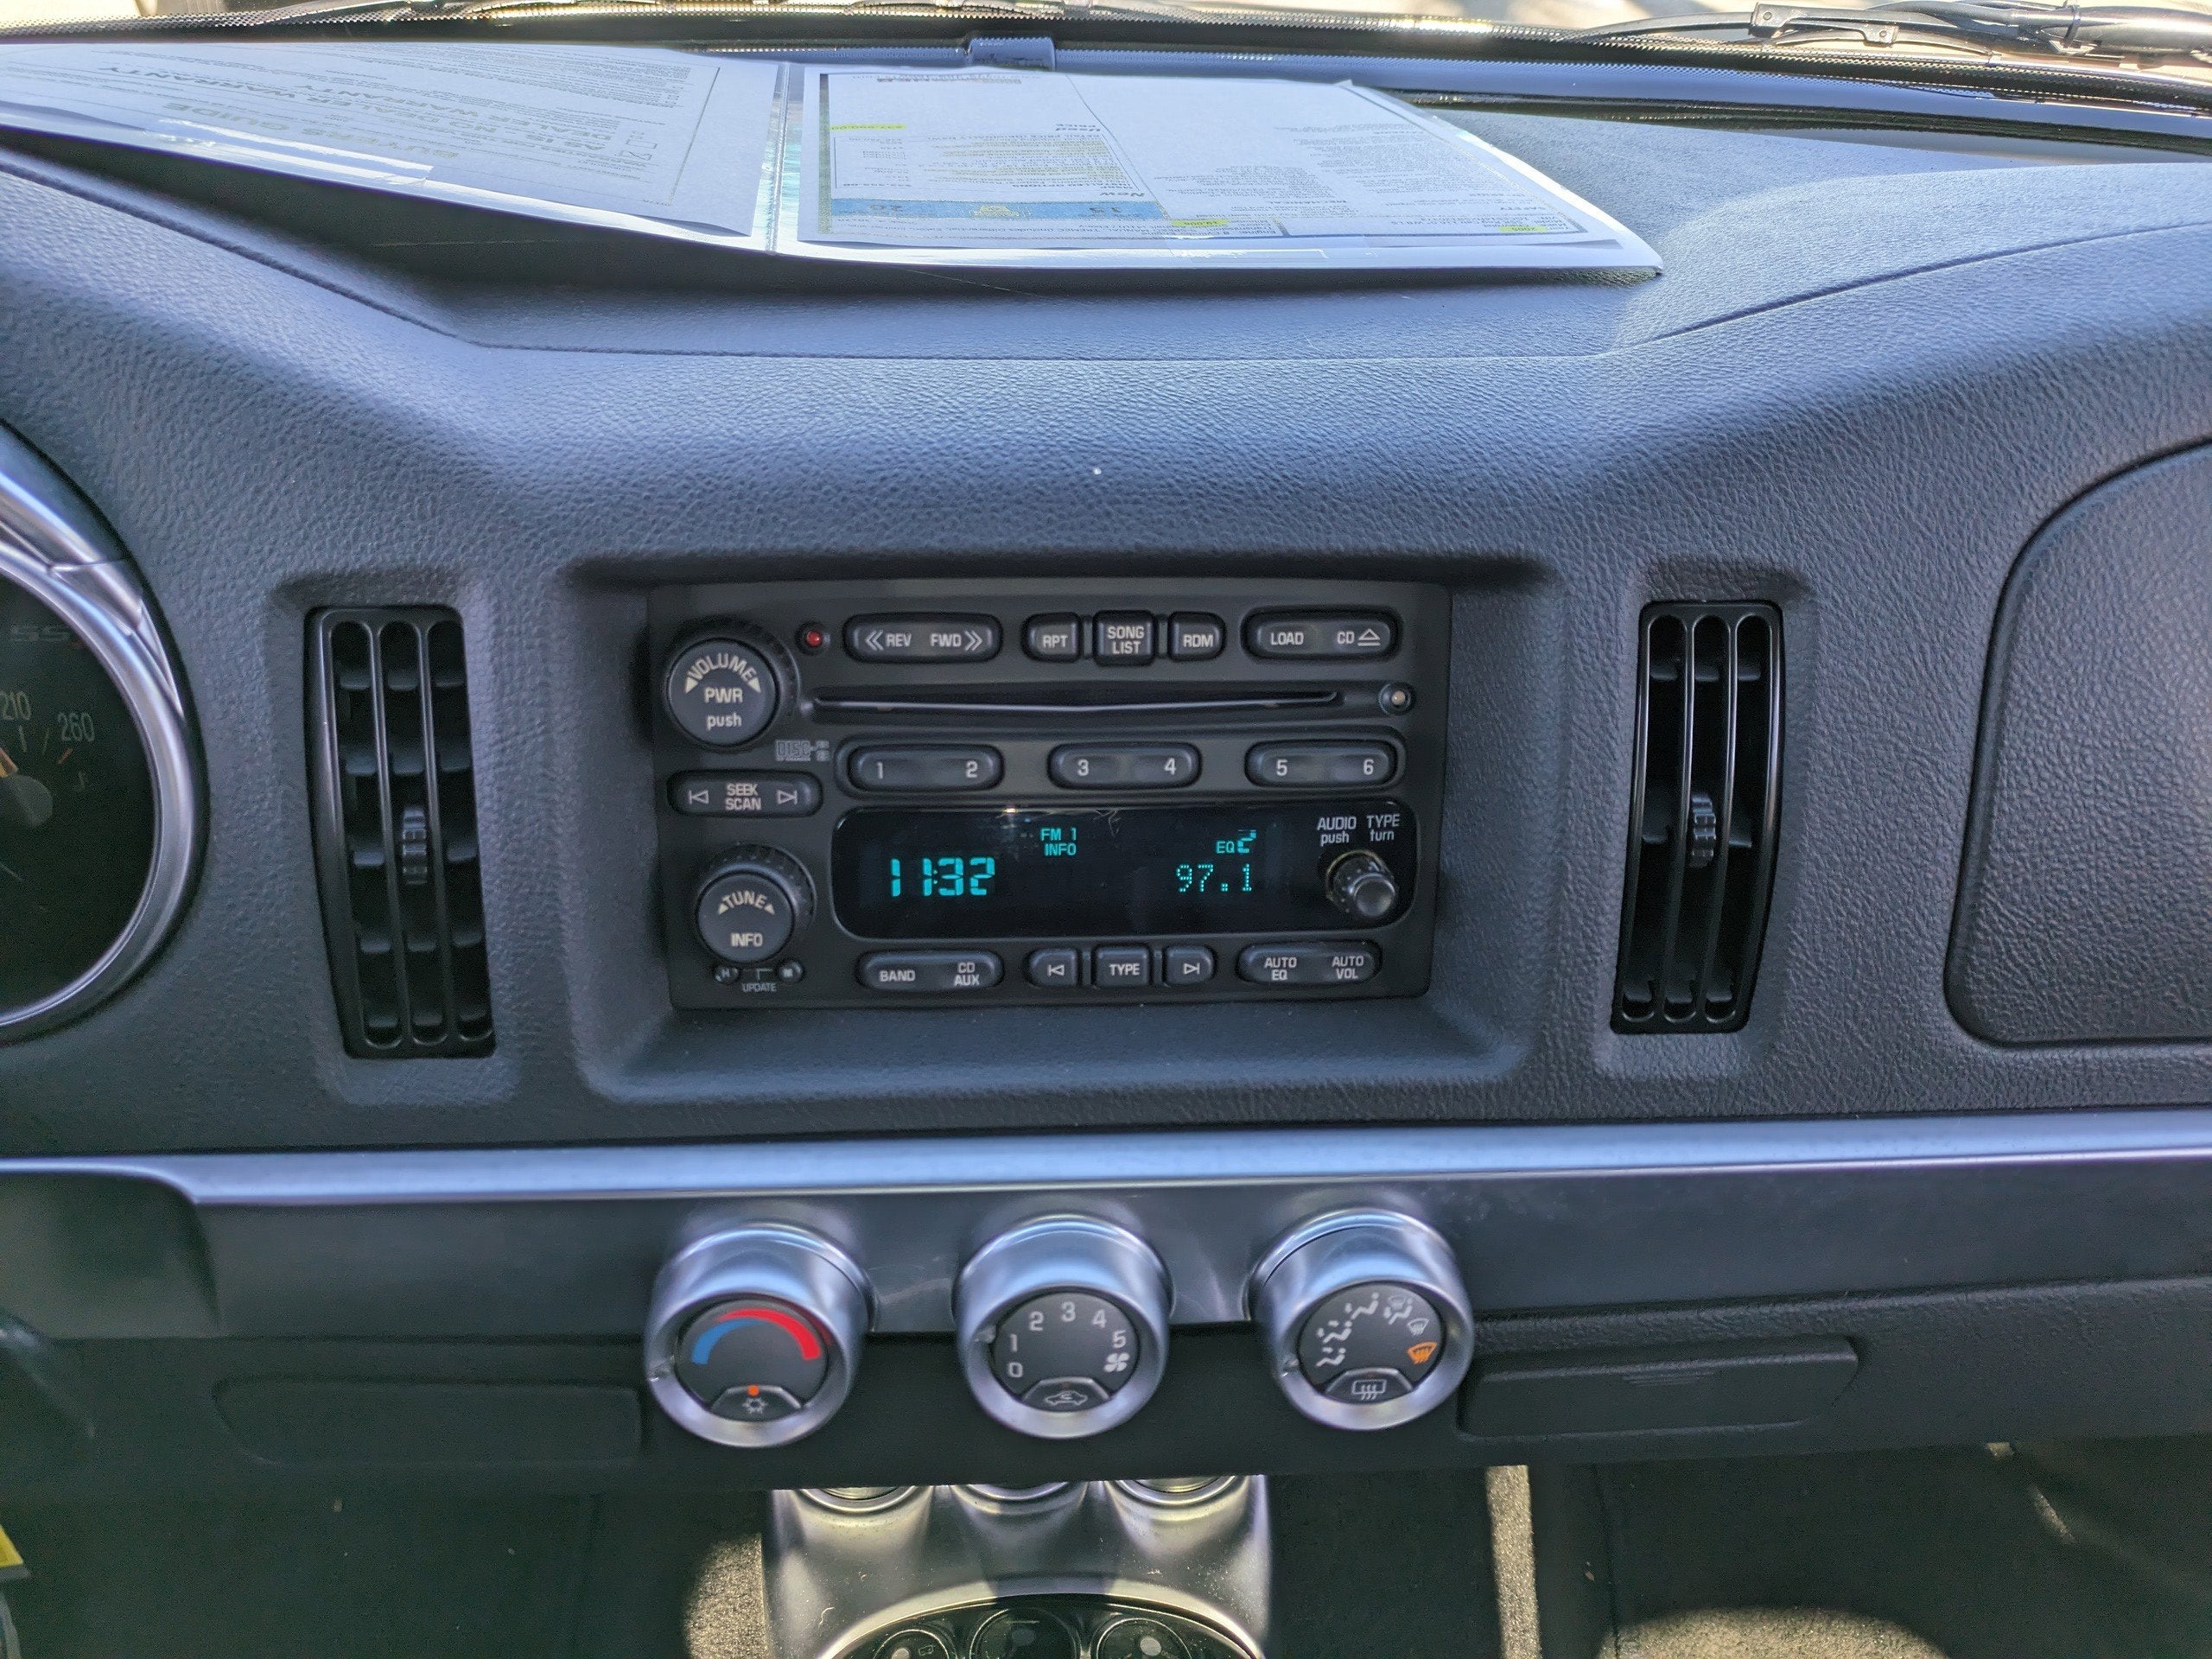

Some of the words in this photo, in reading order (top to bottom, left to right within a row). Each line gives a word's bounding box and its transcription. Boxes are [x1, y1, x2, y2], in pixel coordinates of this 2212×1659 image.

[98, 67, 296, 99] WARRANTY
[162, 103, 290, 130] GUIDE
[886, 632, 912, 647] REV
[930, 632, 963, 648] FWD
[1041, 633, 1069, 648] RPT
[1107, 625, 1146, 640] SONG
[1182, 633, 1214, 648] RDM
[1269, 632, 1305, 646] LOAD
[1336, 632, 1355, 645] CD
[1111, 640, 1142, 655] LIST
[688, 652, 757, 682] VOLUME
[704, 687, 743, 704] PWR
[57, 711, 96, 743] 260
[706, 713, 742, 730] push
[875, 761, 884, 779] 1
[965, 761, 978, 779] 2
[1076, 759, 1090, 777] 3
[1163, 757, 1177, 775] 4
[1274, 759, 1288, 777] 5
[1362, 758, 1375, 775] 6
[726, 783, 760, 797] SEEK
[725, 797, 762, 811] SCAN
[1317, 816, 1357, 830] AUDIO
[1366, 814, 1401, 828] TYPE
[1040, 827, 1062, 842] FM
[1320, 832, 1350, 846] push
[1370, 830, 1395, 842] turn
[1044, 842, 1077, 856] INFO
[1175, 863, 1253, 893] 97.1
[722, 890, 768, 910] TUNE
[730, 932, 764, 948] INFO
[957, 961, 976, 974] CD
[1109, 963, 1141, 976] TYPE
[1264, 956, 1297, 969] AUTO
[1332, 955, 1364, 968] AUTO
[879, 969, 917, 982] BAND
[954, 974, 980, 987] AUX
[1271, 969, 1288, 982] EQ
[1336, 968, 1359, 981] VOL
[741, 982, 778, 993] UPDATE
[1060, 1302, 1077, 1323] 3
[1091, 1309, 1108, 1328] 4
[1028, 1311, 1045, 1332] 2
[1009, 1333, 1019, 1352] 1
[1112, 1331, 1127, 1349] 5
[1007, 1361, 1023, 1378] 0
